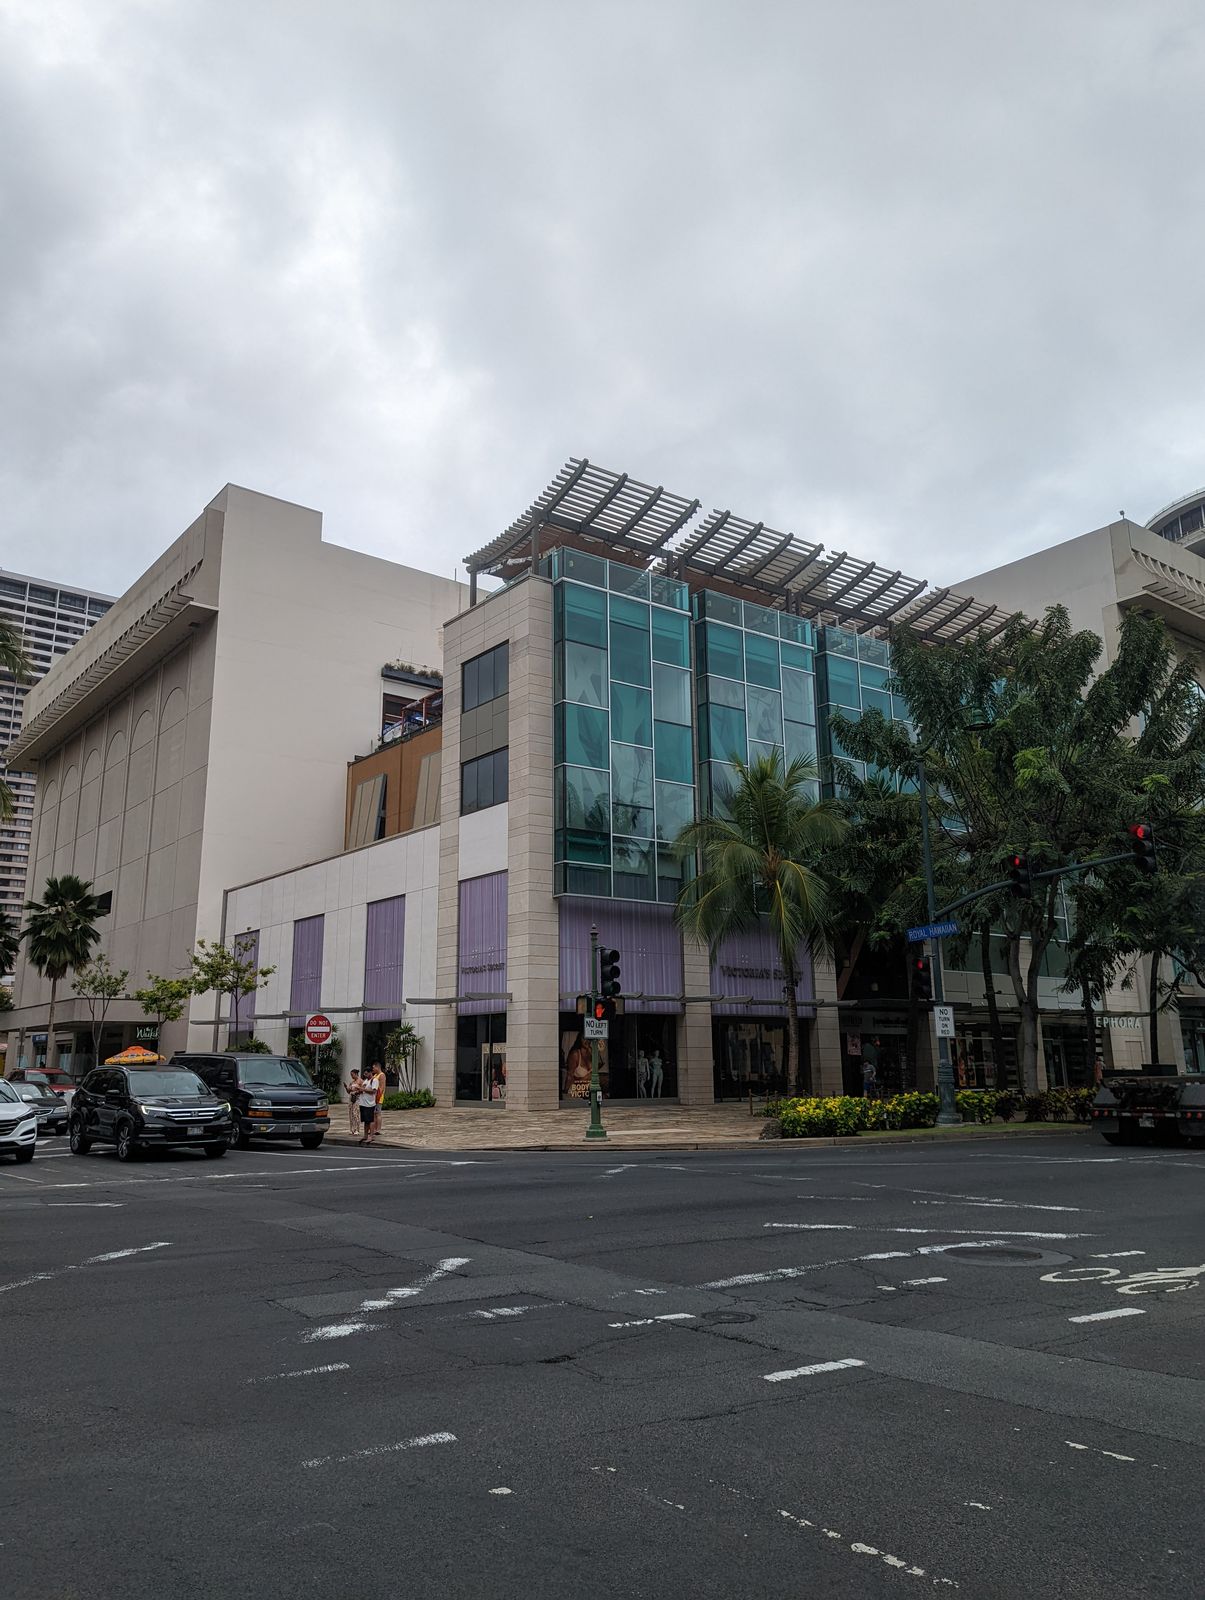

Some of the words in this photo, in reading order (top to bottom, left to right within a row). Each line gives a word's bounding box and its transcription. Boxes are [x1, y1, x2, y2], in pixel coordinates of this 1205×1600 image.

[908, 929, 927, 940] ROYAL
[939, 1008, 949, 1016] NO
[586, 1020, 595, 1028] NO
[1095, 1016, 1141, 1029] EPHORA
